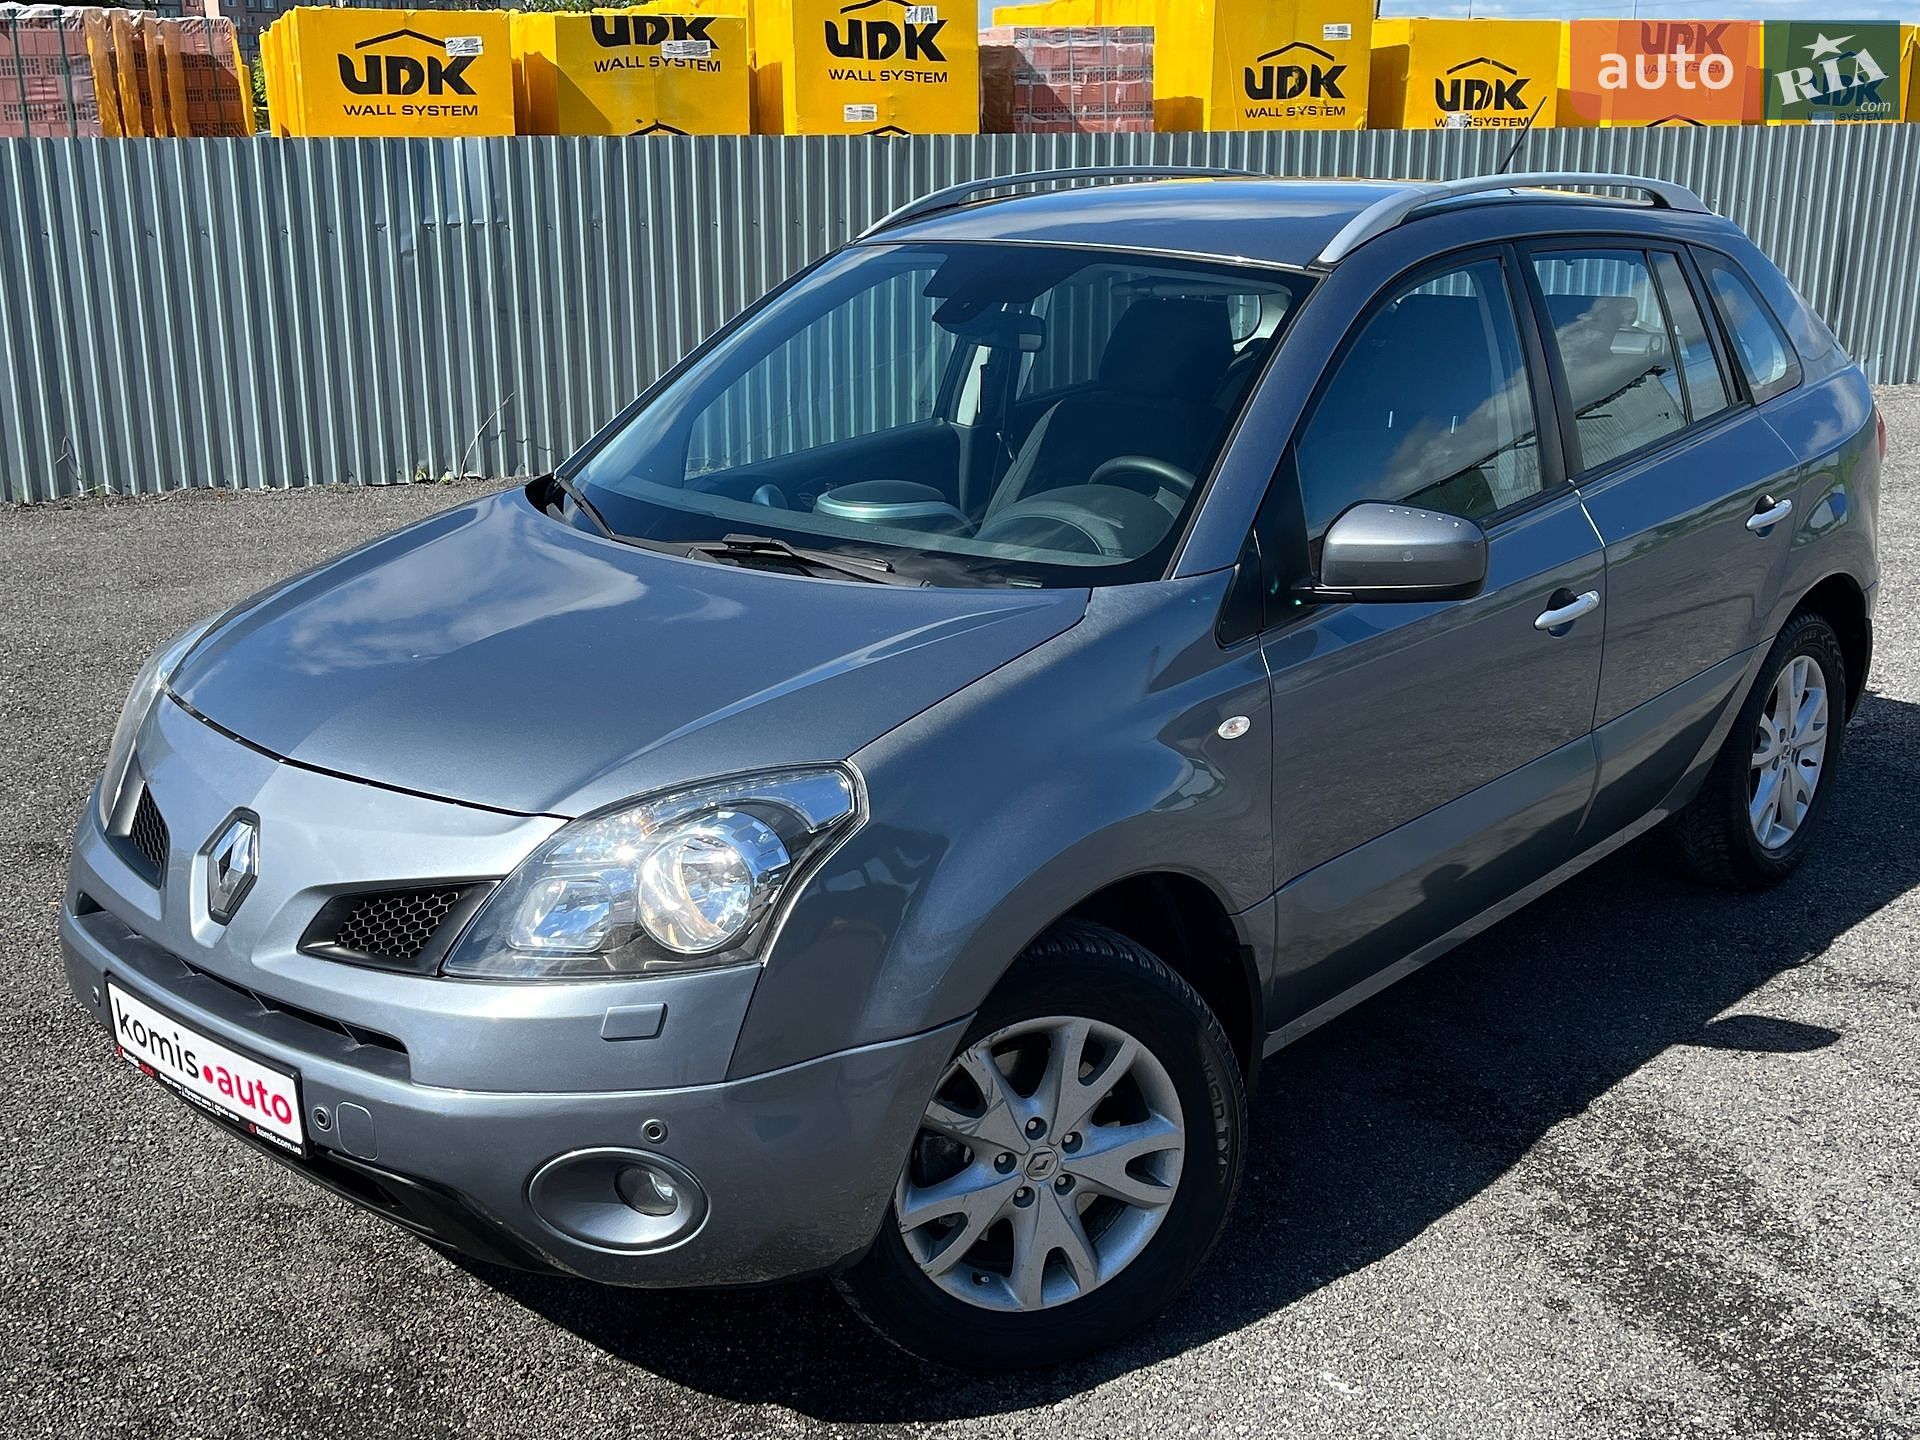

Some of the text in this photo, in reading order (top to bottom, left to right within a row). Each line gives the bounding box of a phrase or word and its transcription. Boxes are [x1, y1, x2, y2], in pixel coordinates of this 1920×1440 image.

[591, 15, 720, 49] UDK
[824, 19, 948, 62] UDK
[1641, 22, 1731, 56] UDK
[337, 53, 478, 95] UDK
[594, 56, 721, 72] WALL SYSTEM
[829, 69, 948, 83] WALL SYSTEM
[1244, 64, 1348, 100] UDK
[1435, 78, 1531, 111] UDK
[343, 105, 478, 117] WALL SYSTEM
[1245, 106, 1346, 118] WALL SYSTEM
[1473, 117, 1530, 128] SYSTEM
[1839, 112, 1884, 122] SYSTEM
